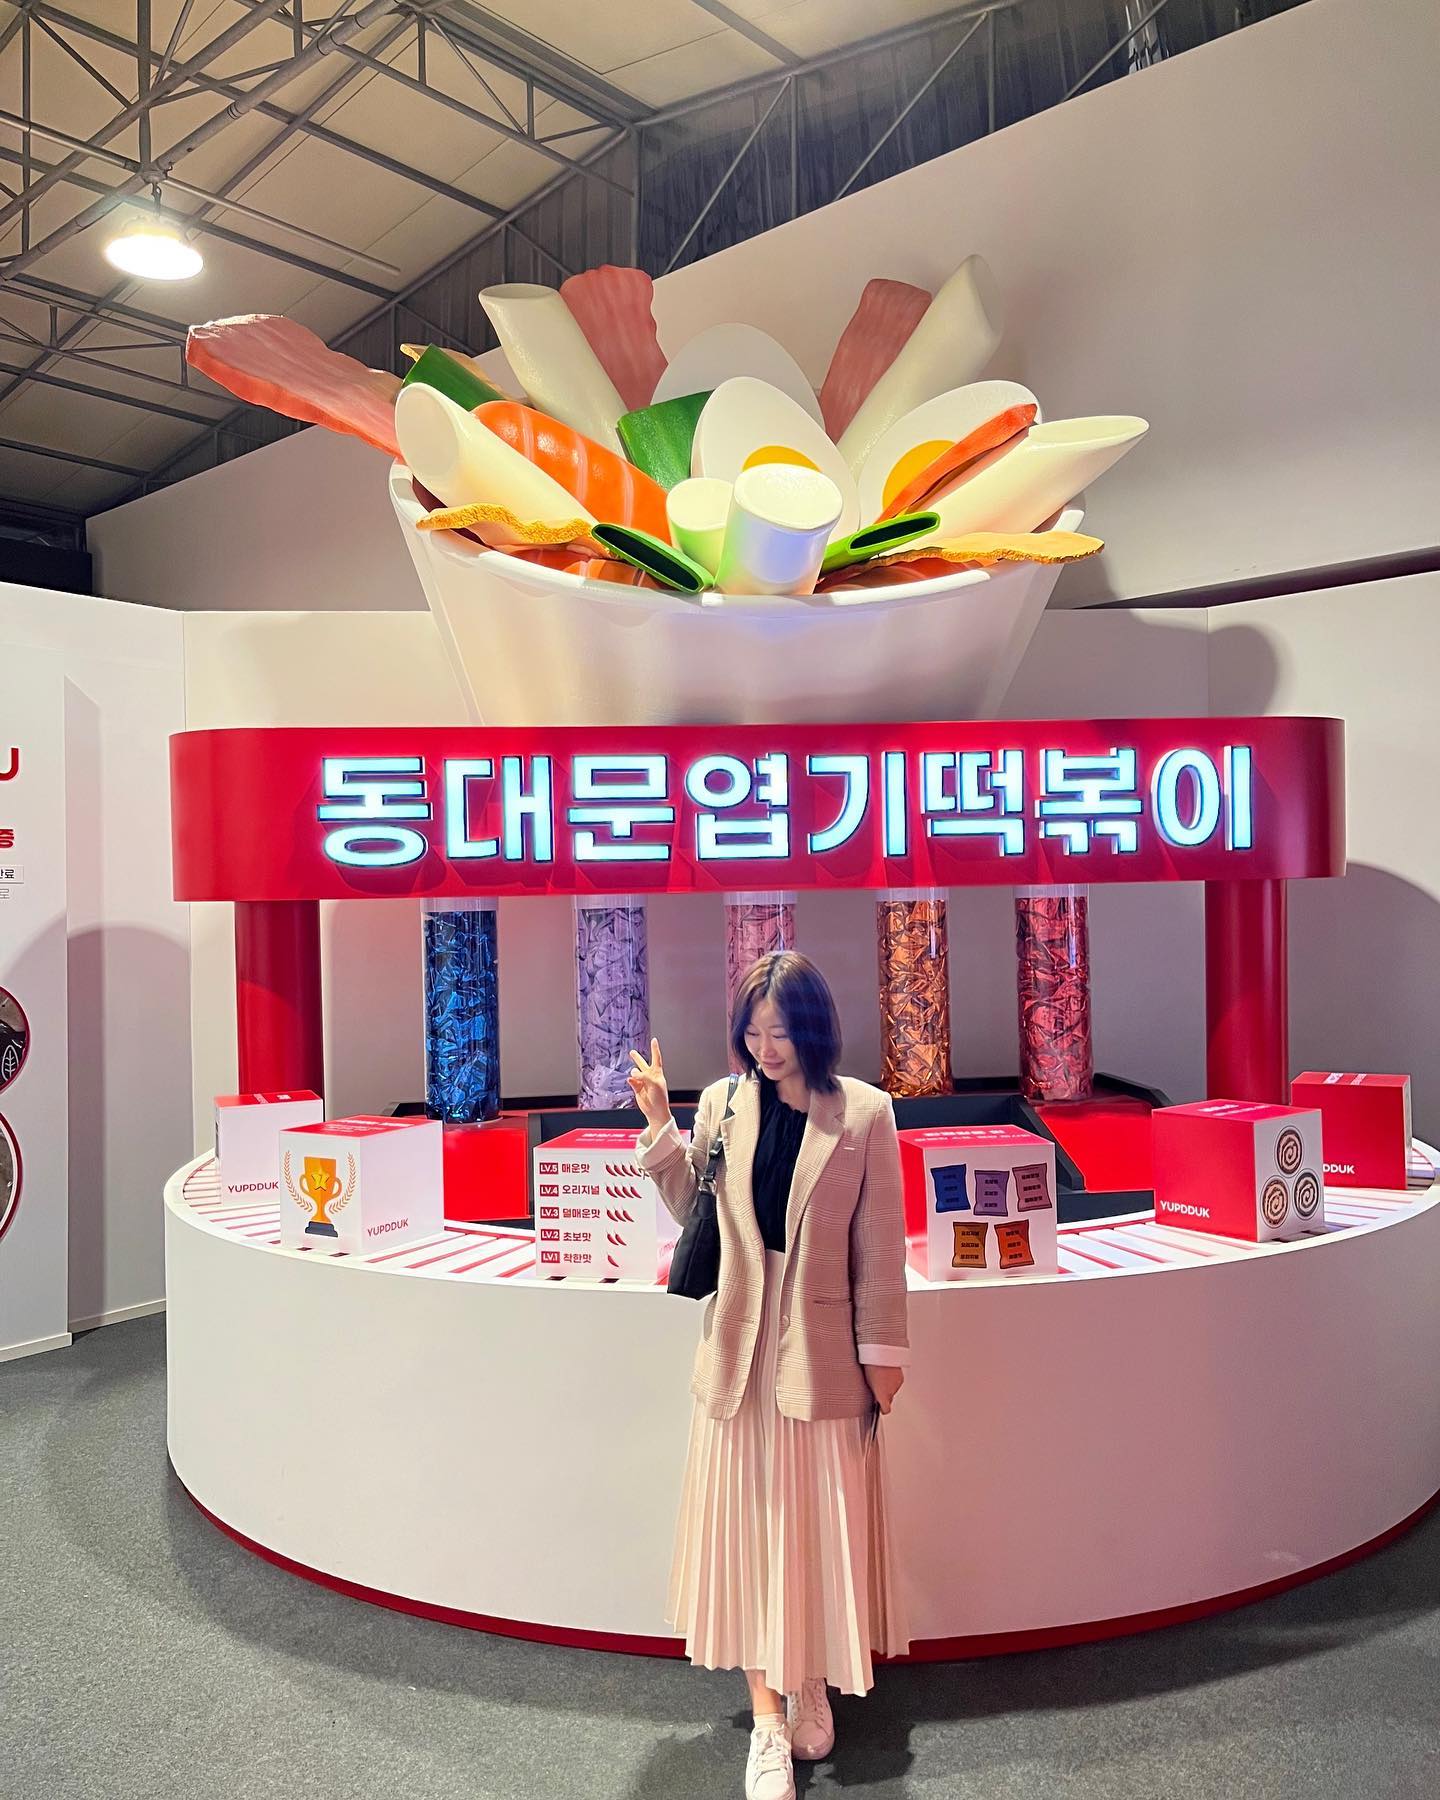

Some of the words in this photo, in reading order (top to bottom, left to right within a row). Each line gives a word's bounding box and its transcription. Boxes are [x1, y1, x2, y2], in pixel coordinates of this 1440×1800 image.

[317, 745, 1253, 867] 동대문엽기떡볶이
[540, 1164, 558, 1173] LV.5
[562, 1163, 590, 1173] 매운맛
[1322, 1163, 1355, 1174] DDUK
[228, 1181, 279, 1193] YUPDDUK
[541, 1186, 558, 1195] LV.4
[562, 1185, 600, 1195] 오리지널
[541, 1208, 559, 1217] LV.3
[562, 1208, 600, 1219] 덜매운맛
[1160, 1200, 1210, 1219] YUPDDUK
[367, 1218, 408, 1237] YUPDDUK
[542, 1230, 559, 1239] LV.2
[563, 1232, 591, 1242] 초보맛
[543, 1253, 558, 1262] LV.1
[563, 1253, 592, 1264] 착한맛
